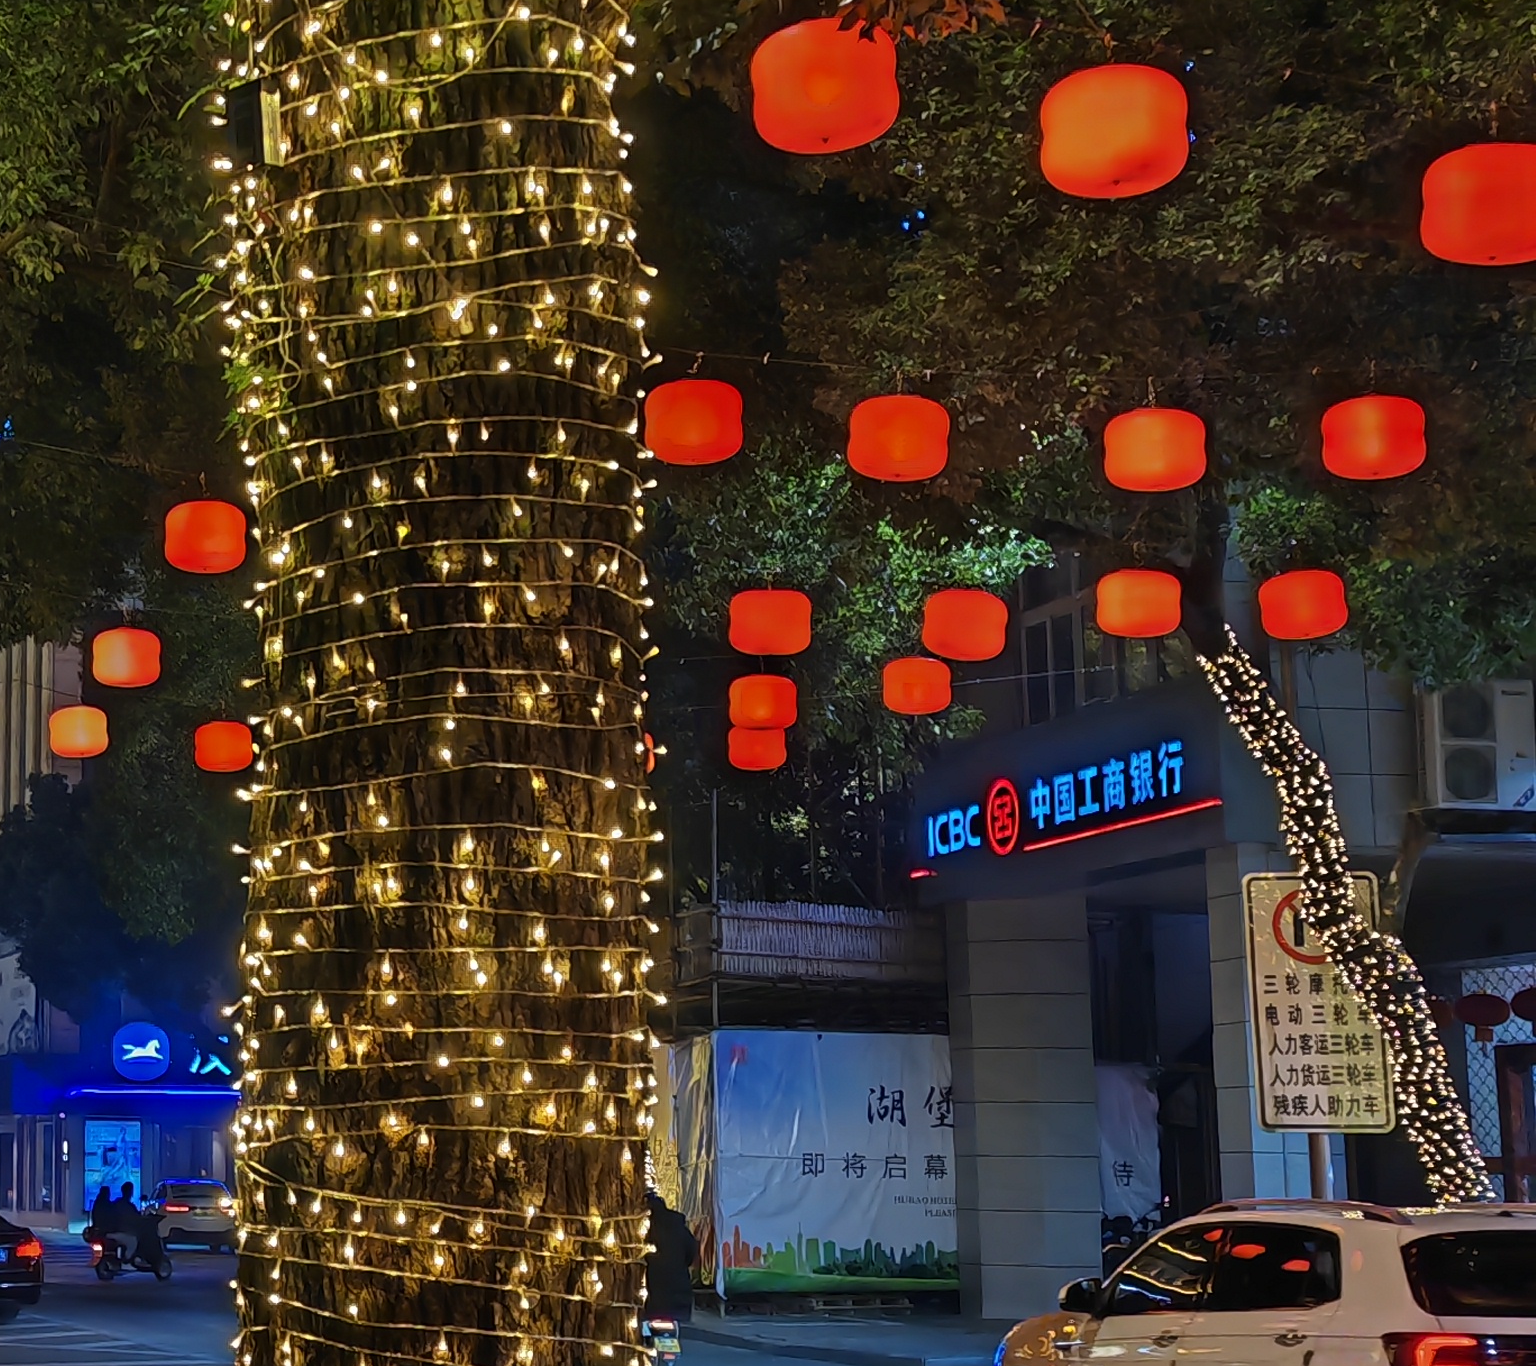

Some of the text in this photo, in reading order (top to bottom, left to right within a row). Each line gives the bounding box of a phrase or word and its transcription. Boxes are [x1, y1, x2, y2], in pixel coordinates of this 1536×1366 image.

[1029, 739, 1184, 829] 中国工商银行
[926, 804, 981, 858] ICBC
[1263, 972, 1350, 996] 三轮摩托
[1265, 1002, 1374, 1026] 电动三轮车
[1268, 1032, 1375, 1056] 人力客运三轮车
[1269, 1063, 1377, 1087] 人力货运三轮车
[1273, 1094, 1380, 1117] 残疾人助力车
[801, 1152, 949, 1181] 即将启幕
